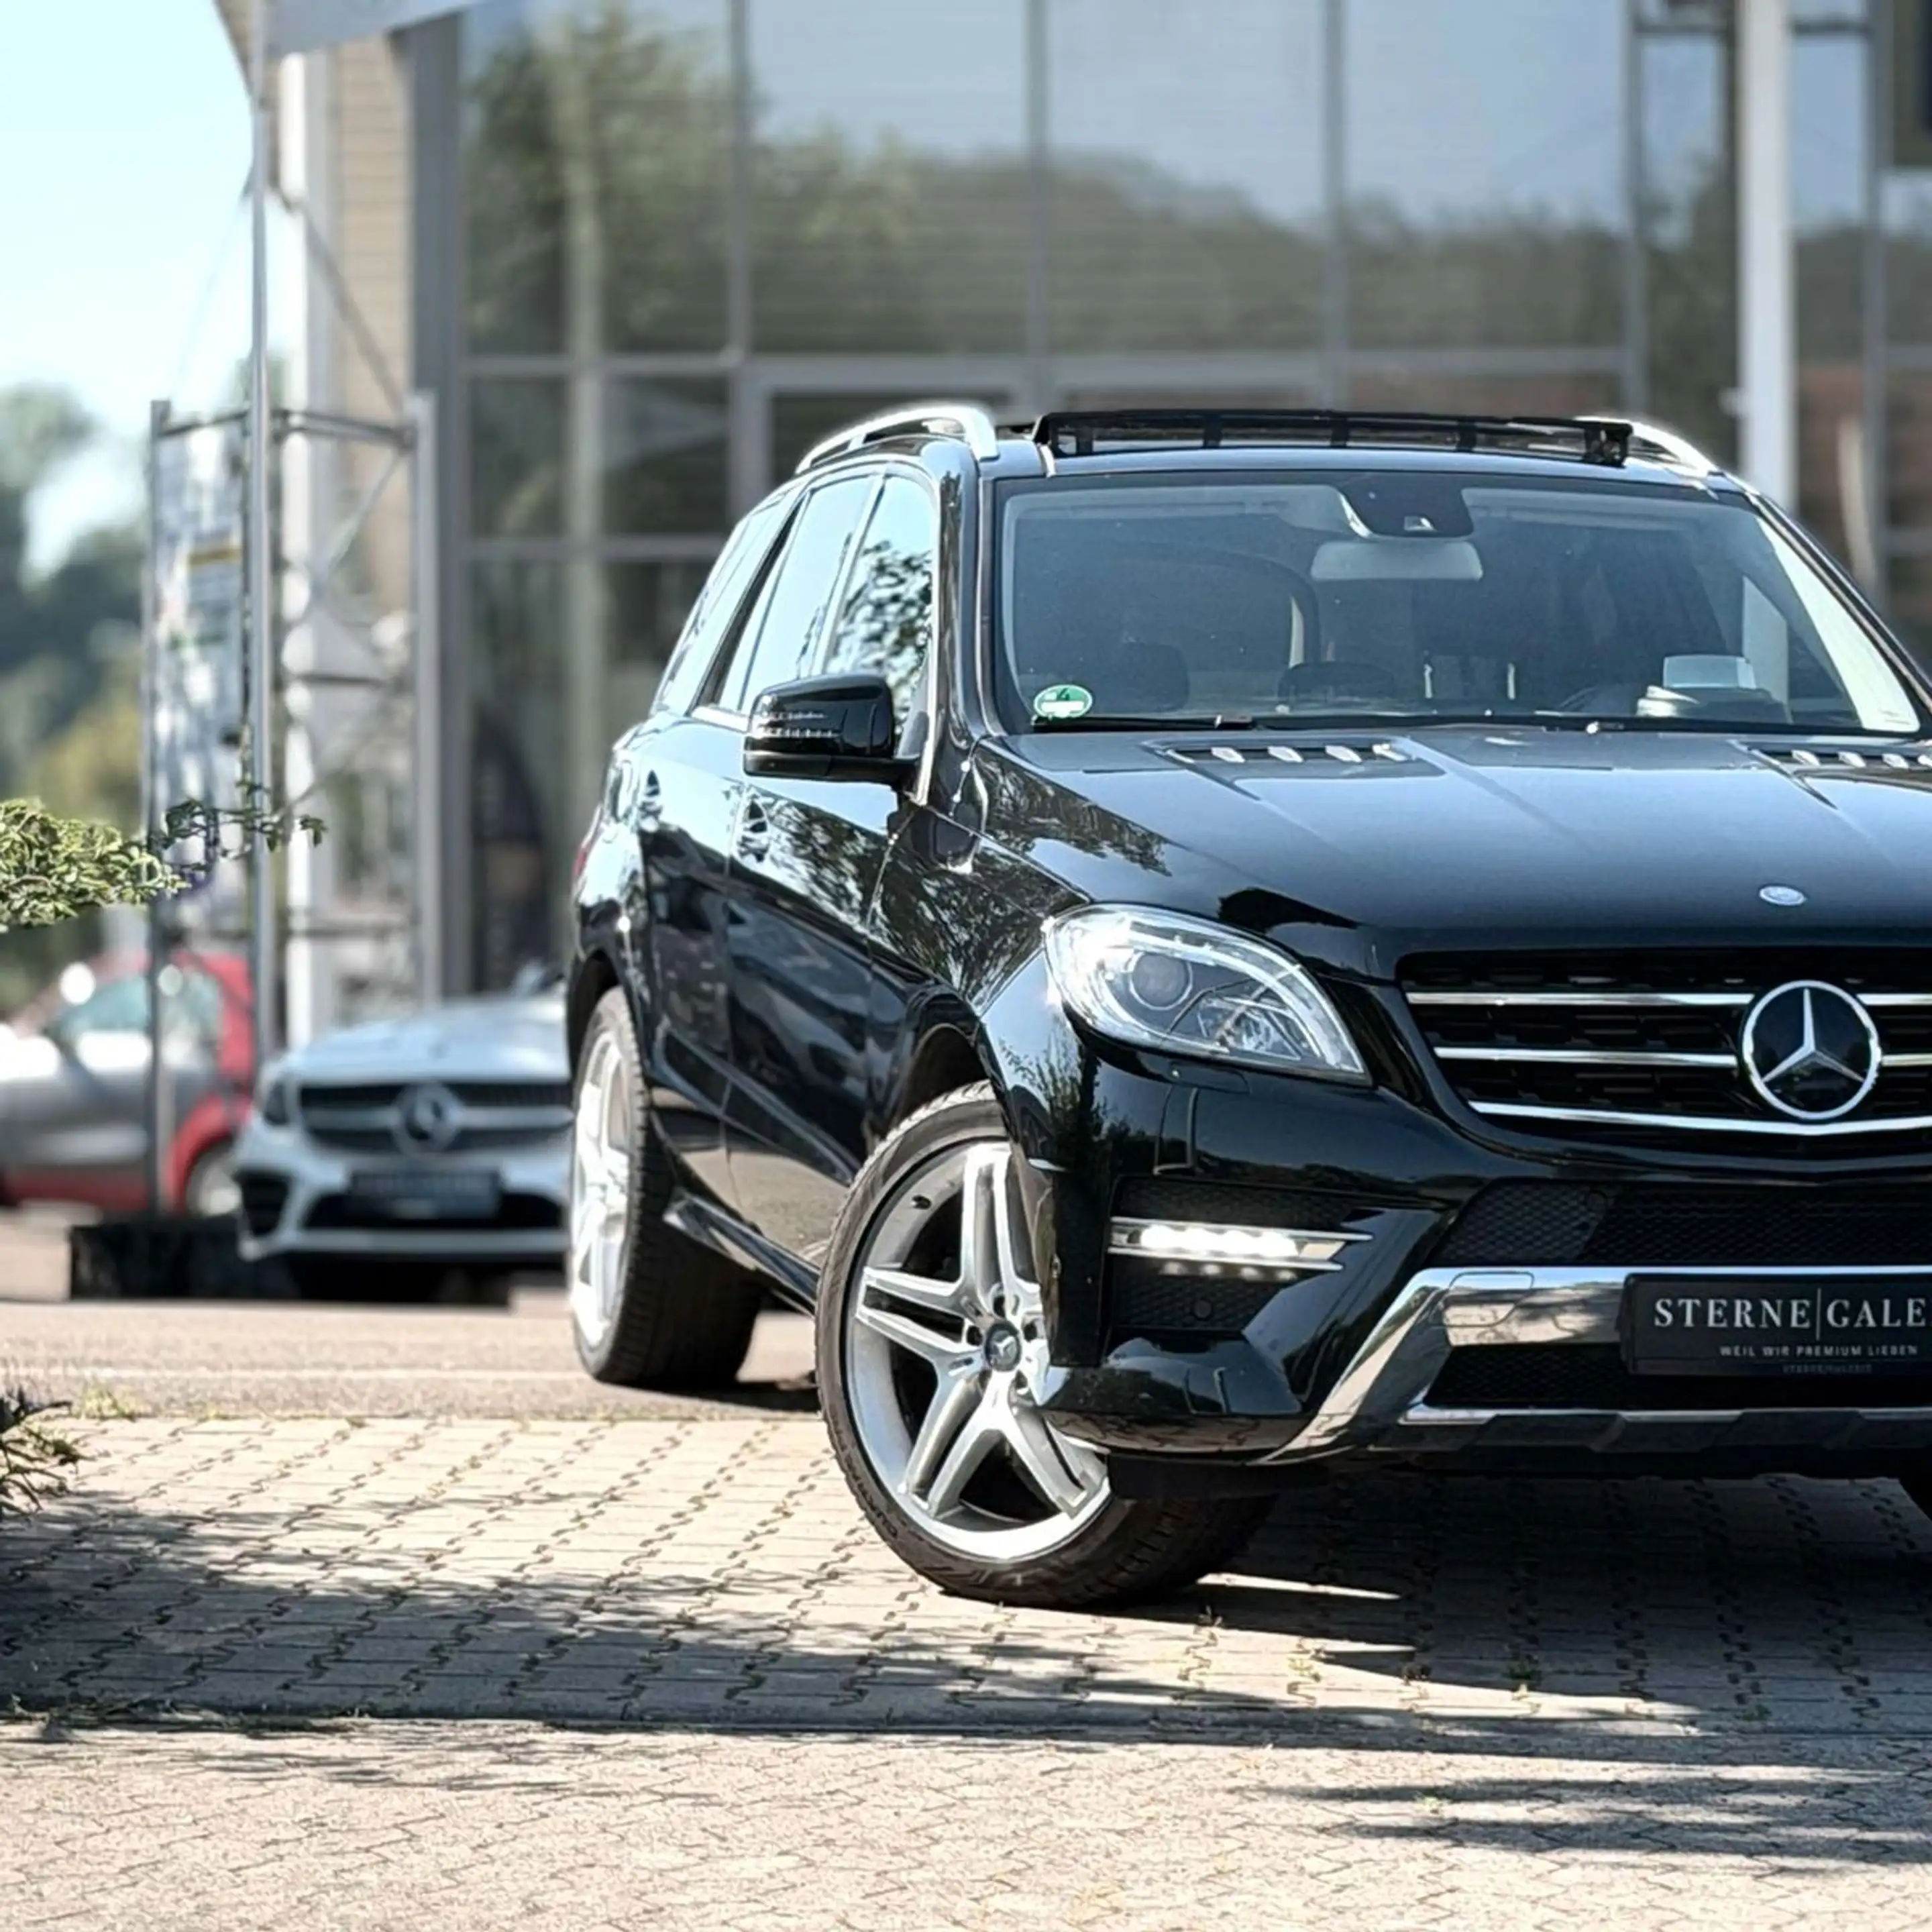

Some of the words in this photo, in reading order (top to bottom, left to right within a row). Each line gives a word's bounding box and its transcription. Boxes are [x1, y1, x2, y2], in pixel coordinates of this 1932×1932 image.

[1654, 1298, 1811, 1328] STERNE
[1719, 1345, 1756, 1356] WEIL
[1763, 1345, 1789, 1356] WIR
[1796, 1344, 1862, 1356] PREMIUM
[1867, 1344, 1918, 1356] LIEBEN
